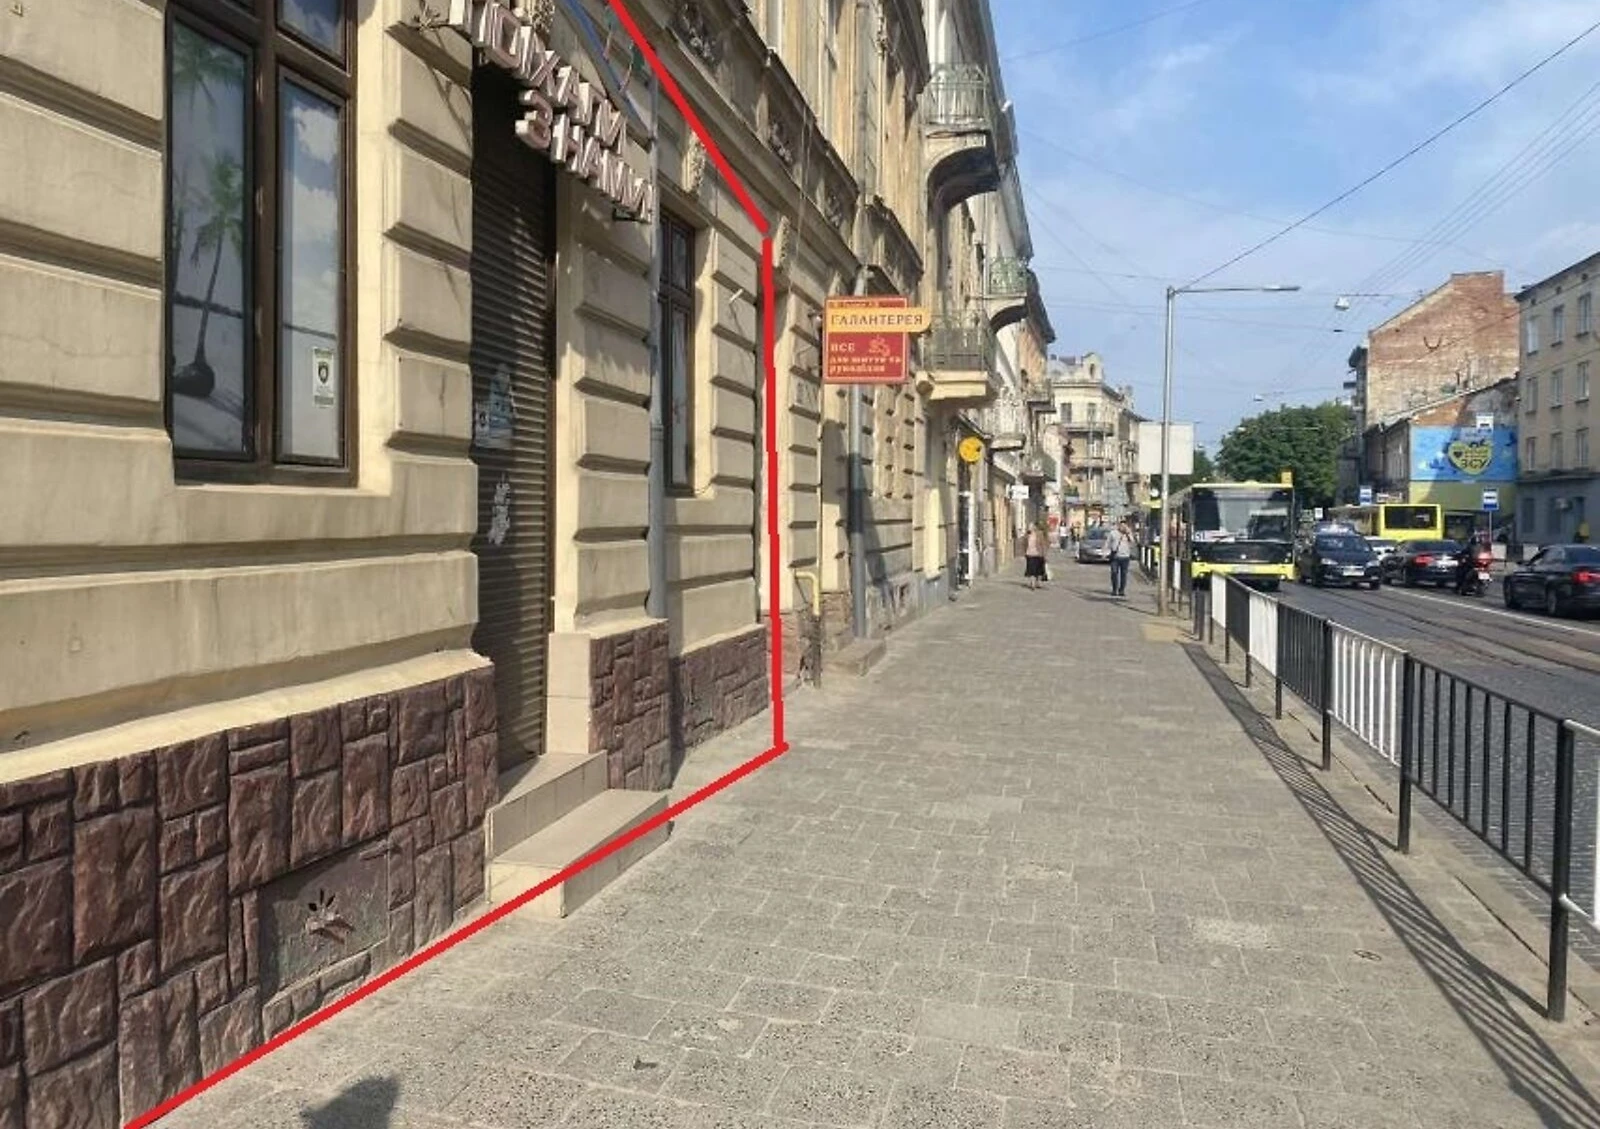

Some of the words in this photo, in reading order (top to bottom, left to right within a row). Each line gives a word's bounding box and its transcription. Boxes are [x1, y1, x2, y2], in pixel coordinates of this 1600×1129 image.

[515, 88, 552, 149] З
[551, 113, 656, 224] НАМИ
[831, 314, 922, 325] ГАЛАНТЕРЕЯ
